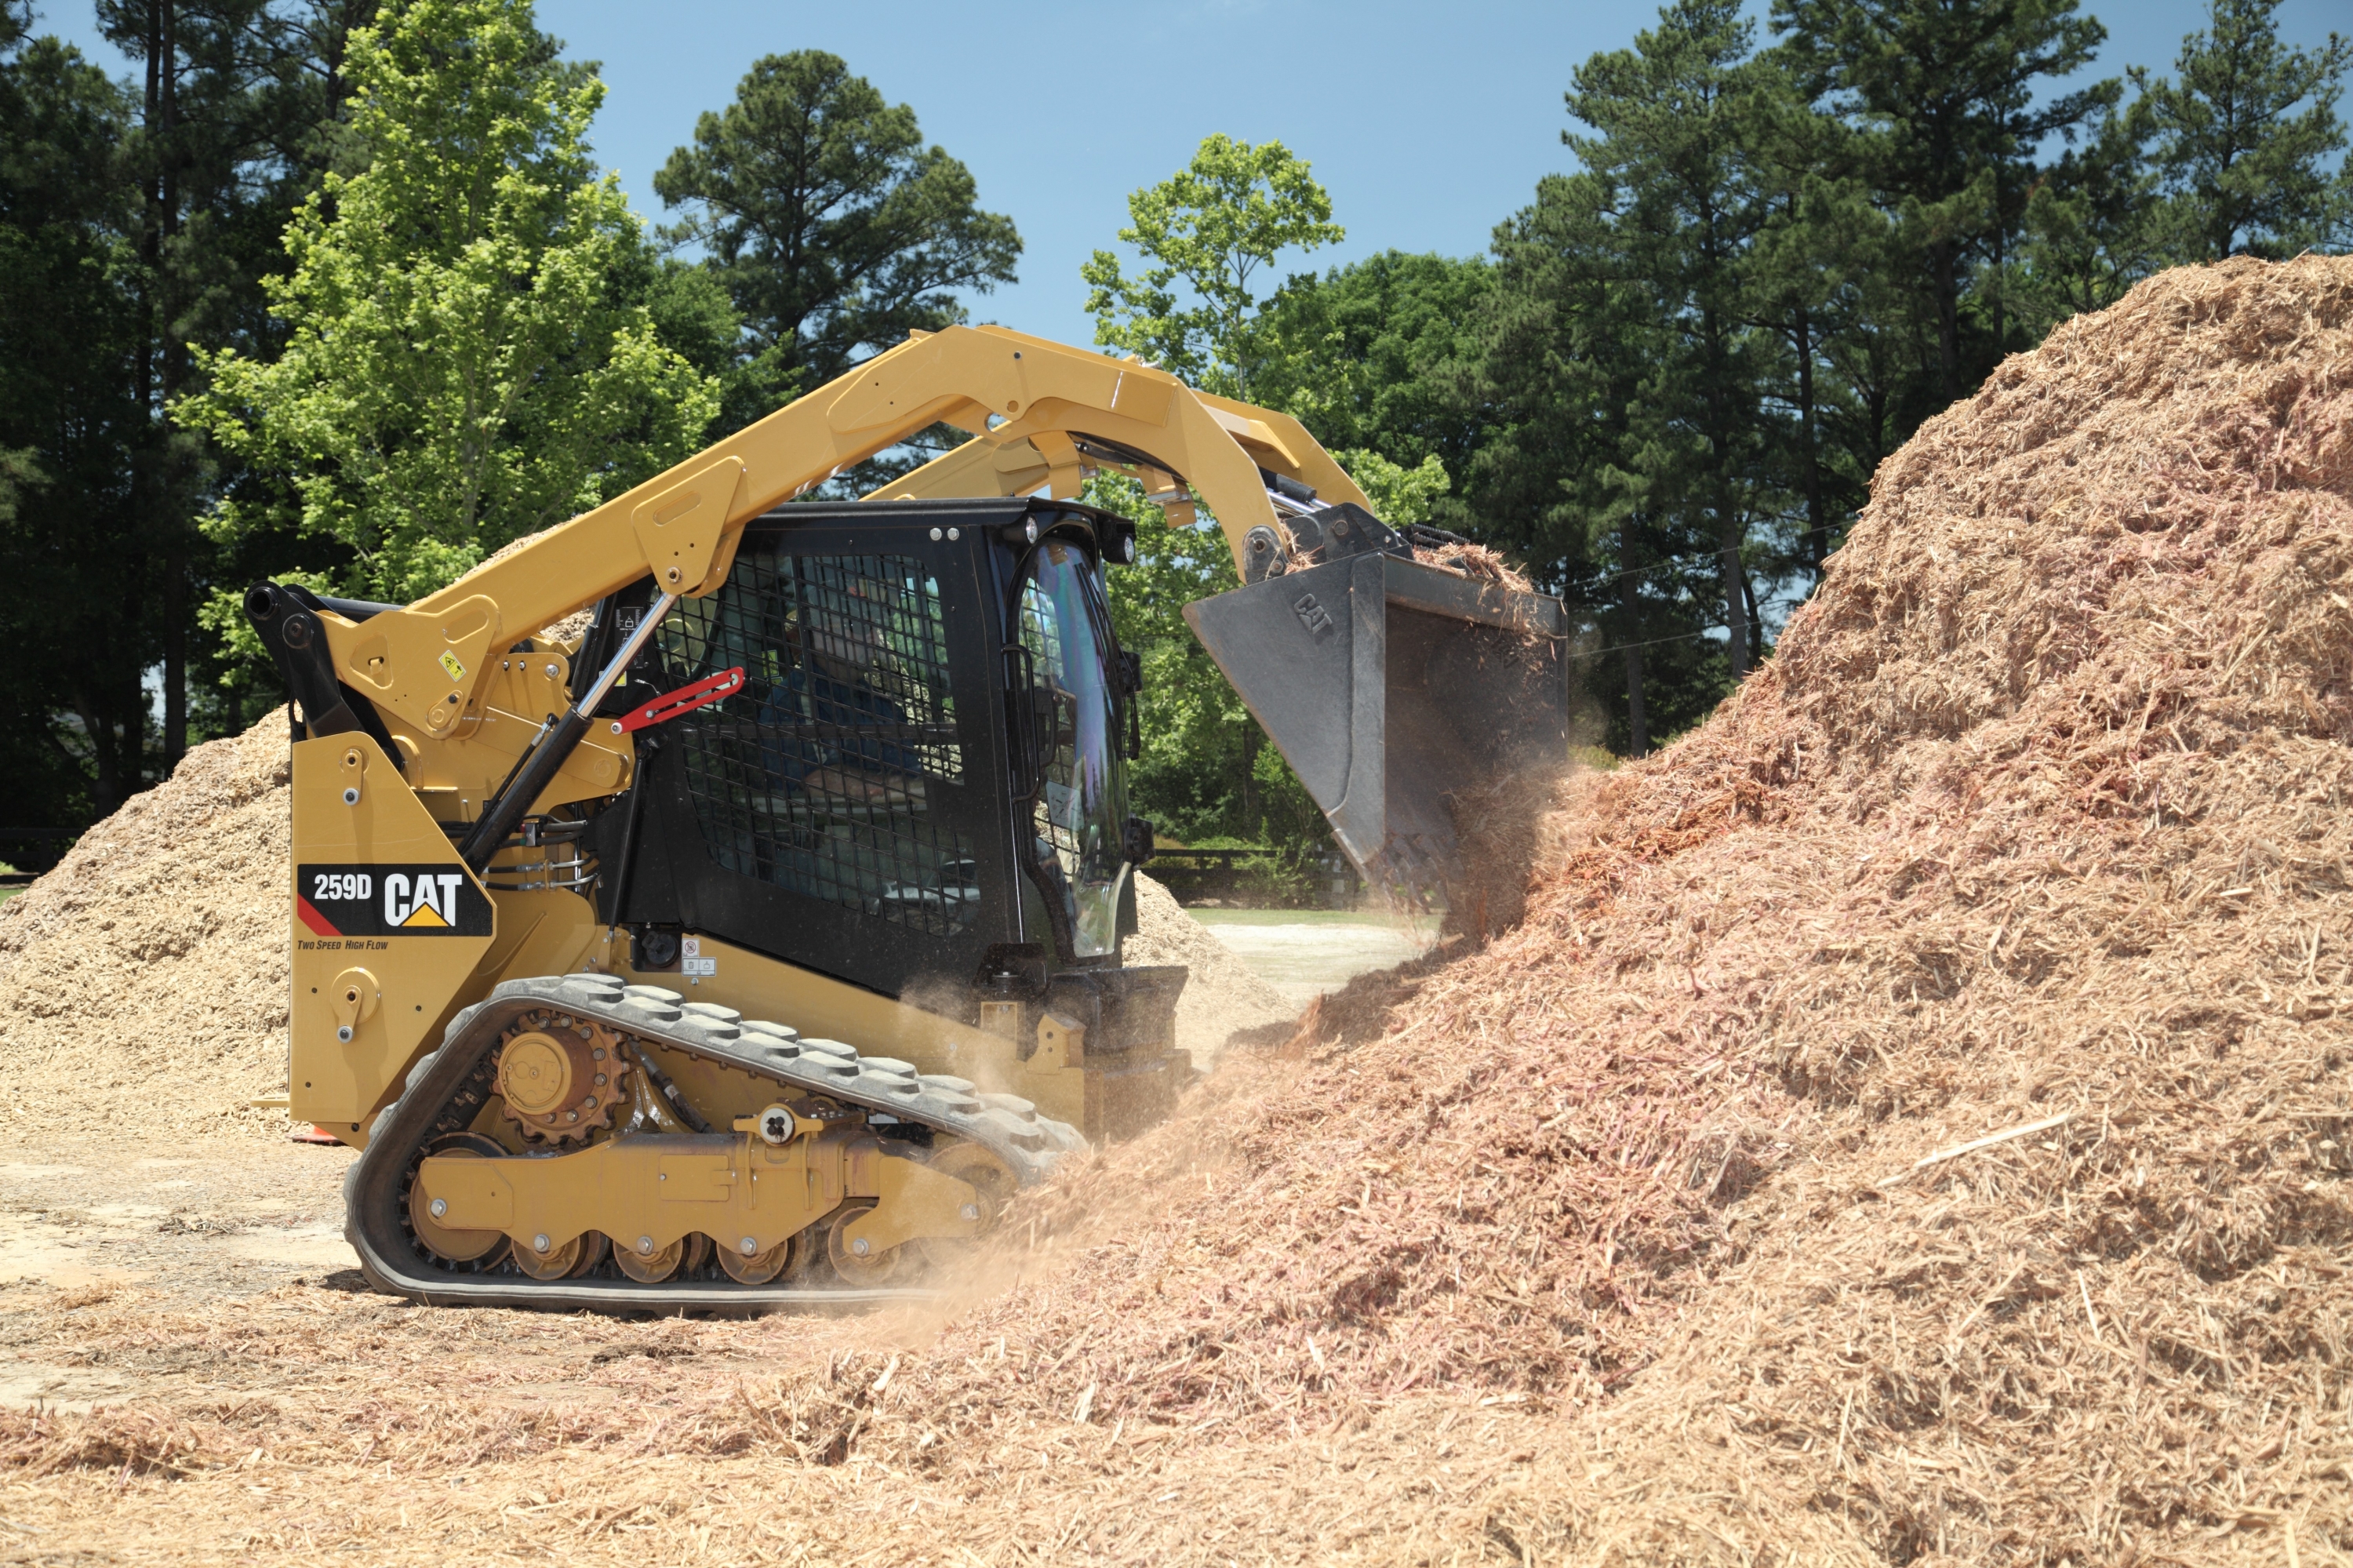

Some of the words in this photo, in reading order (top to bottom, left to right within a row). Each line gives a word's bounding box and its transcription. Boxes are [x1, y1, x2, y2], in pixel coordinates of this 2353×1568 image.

[1293, 593, 1333, 635] CAT
[314, 874, 373, 900] 259D
[384, 873, 463, 927] CAT
